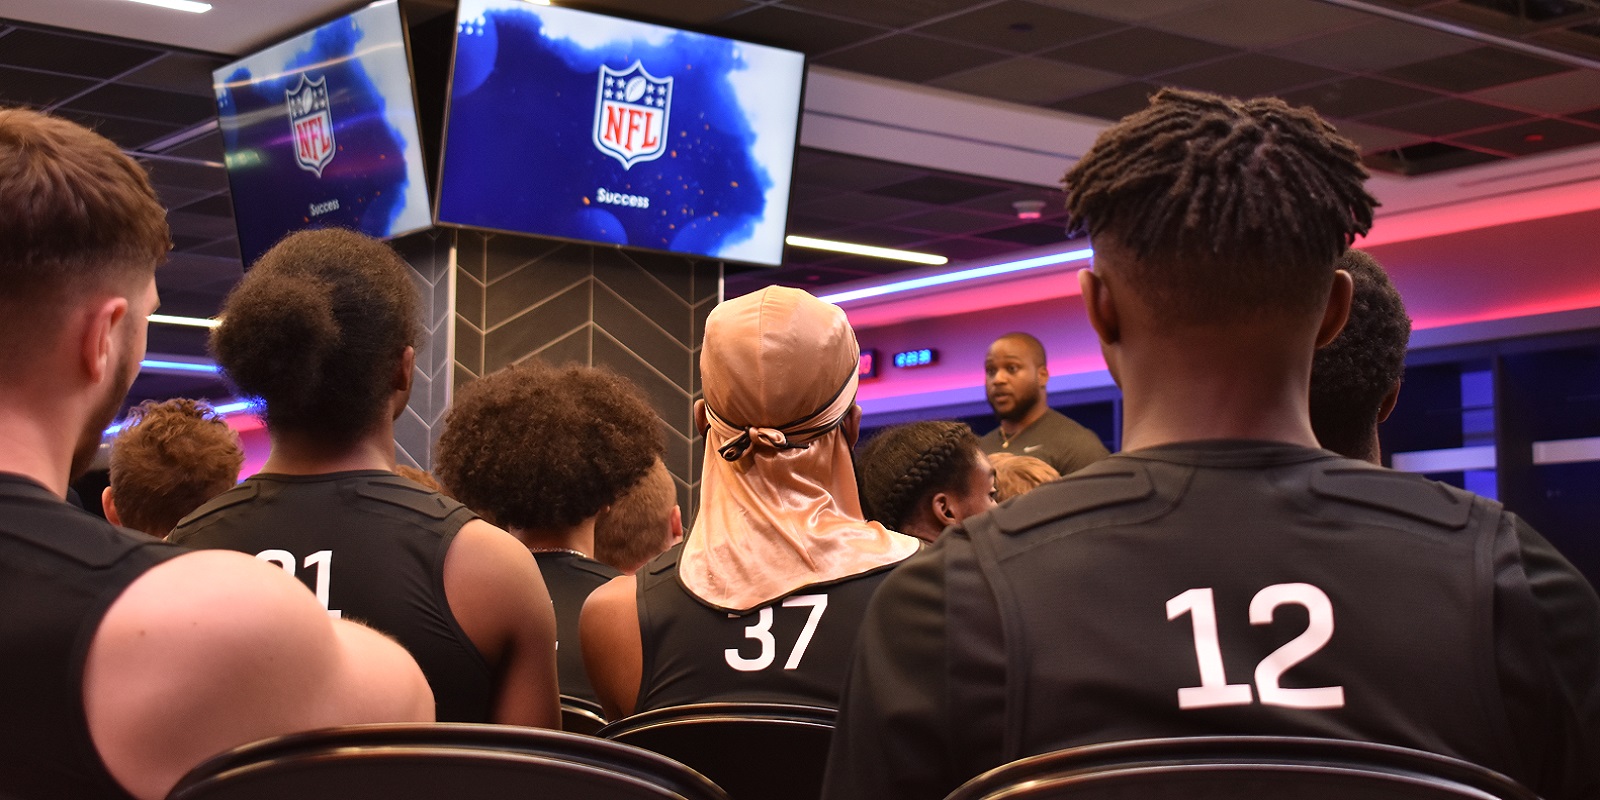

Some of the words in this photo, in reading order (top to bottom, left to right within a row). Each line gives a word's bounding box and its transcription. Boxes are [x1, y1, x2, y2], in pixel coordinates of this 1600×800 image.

[296, 116, 331, 161] NFL
[604, 105, 657, 151] NFL
[309, 199, 340, 216] Success
[597, 187, 650, 209] Success
[255, 549, 342, 619] 1
[724, 593, 828, 671] 37
[1165, 582, 1345, 709] 12
